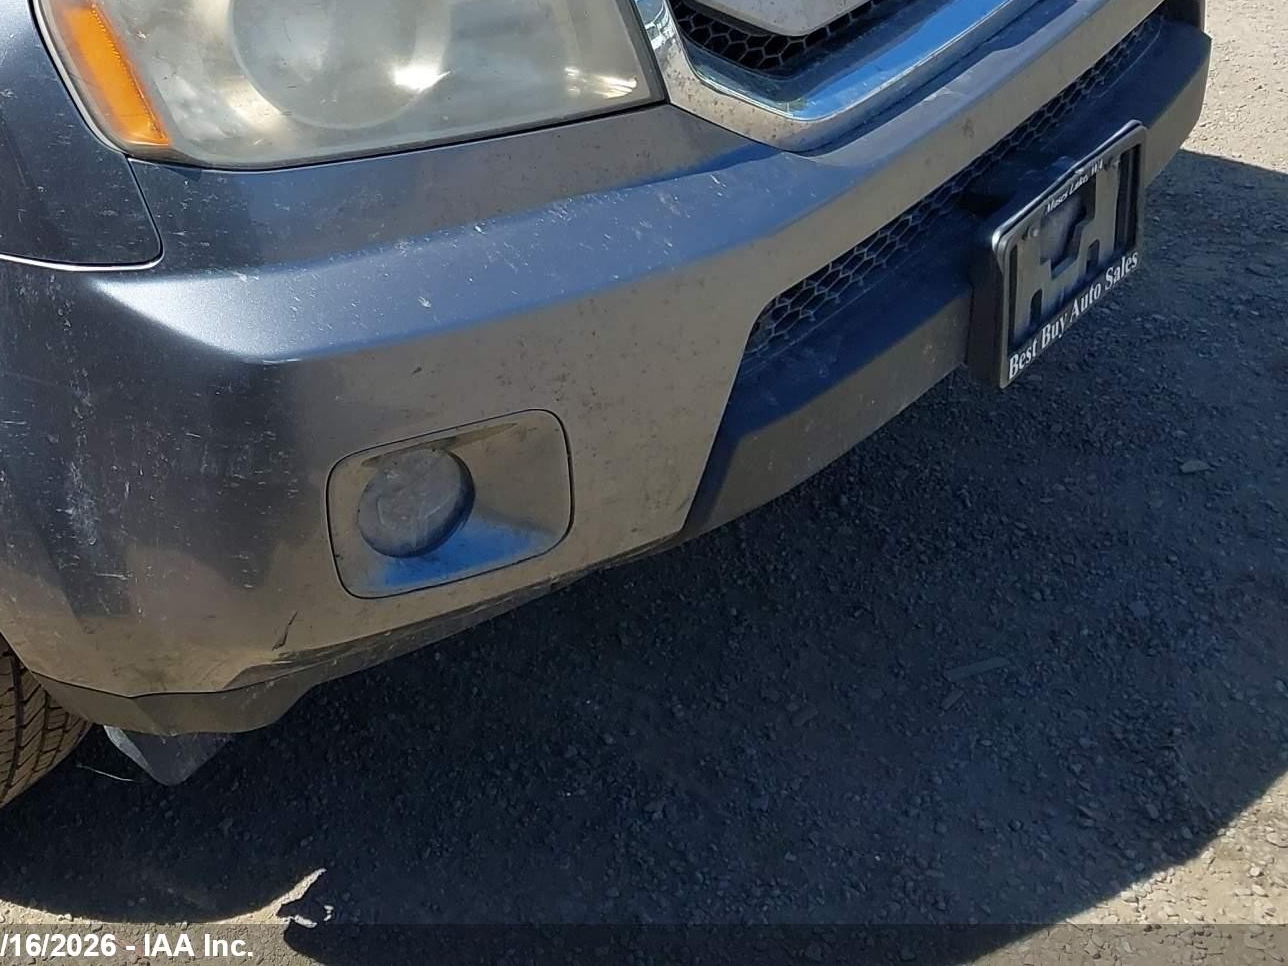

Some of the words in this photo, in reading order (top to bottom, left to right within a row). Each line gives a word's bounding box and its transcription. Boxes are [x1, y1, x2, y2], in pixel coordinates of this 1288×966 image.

[1008, 336, 1038, 380] Best
[1041, 315, 1067, 349] Buy
[1070, 283, 1102, 323] Auto
[1105, 251, 1140, 291] Sales
